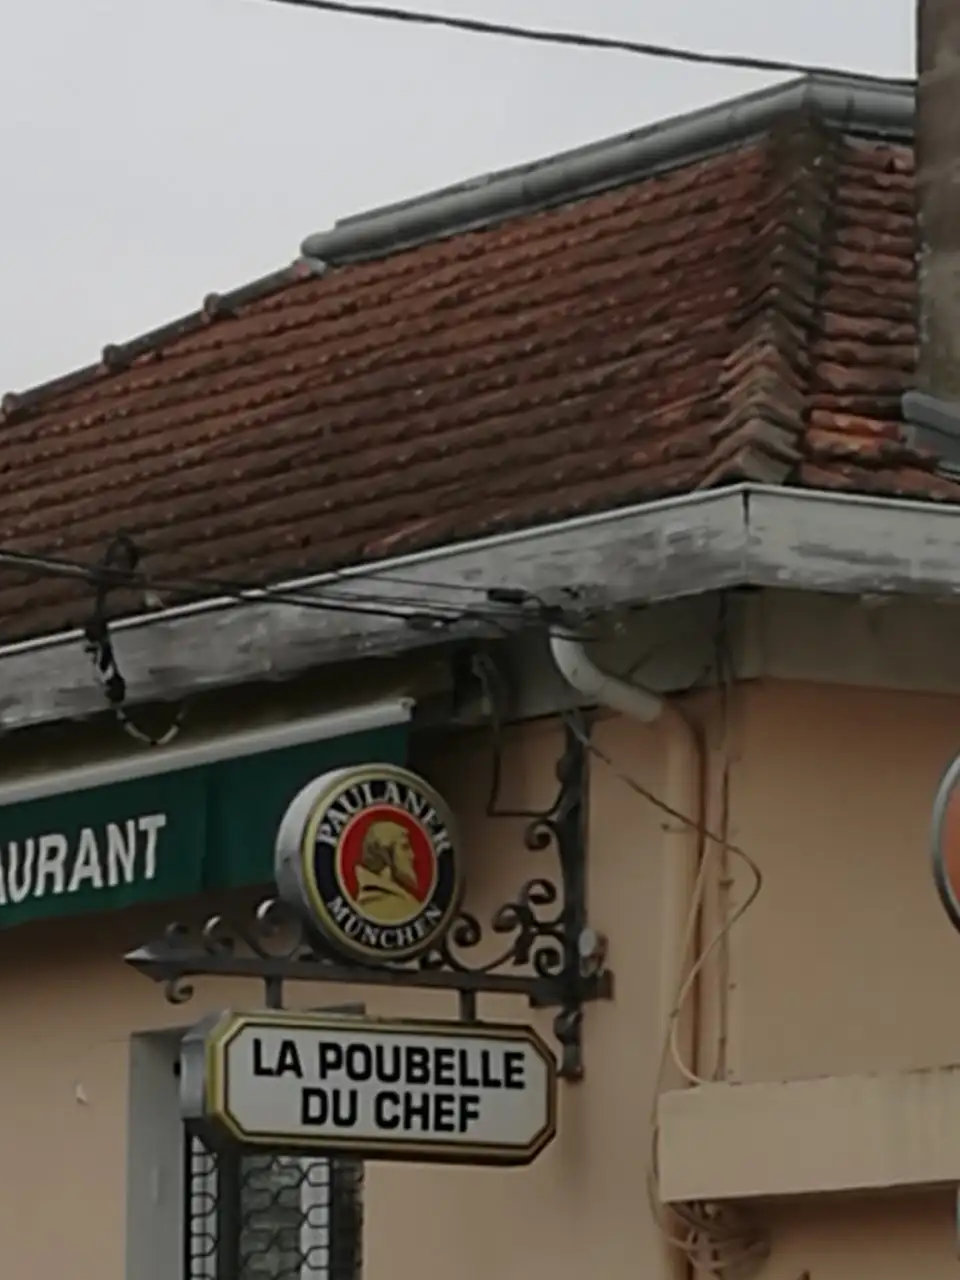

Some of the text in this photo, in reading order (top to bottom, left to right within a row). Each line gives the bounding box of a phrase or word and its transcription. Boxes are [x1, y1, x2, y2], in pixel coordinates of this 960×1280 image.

[317, 780, 452, 857] PAULANER
[252, 1037, 527, 1089] LA POUBELLE
[299, 1087, 481, 1134] DU CHEF
